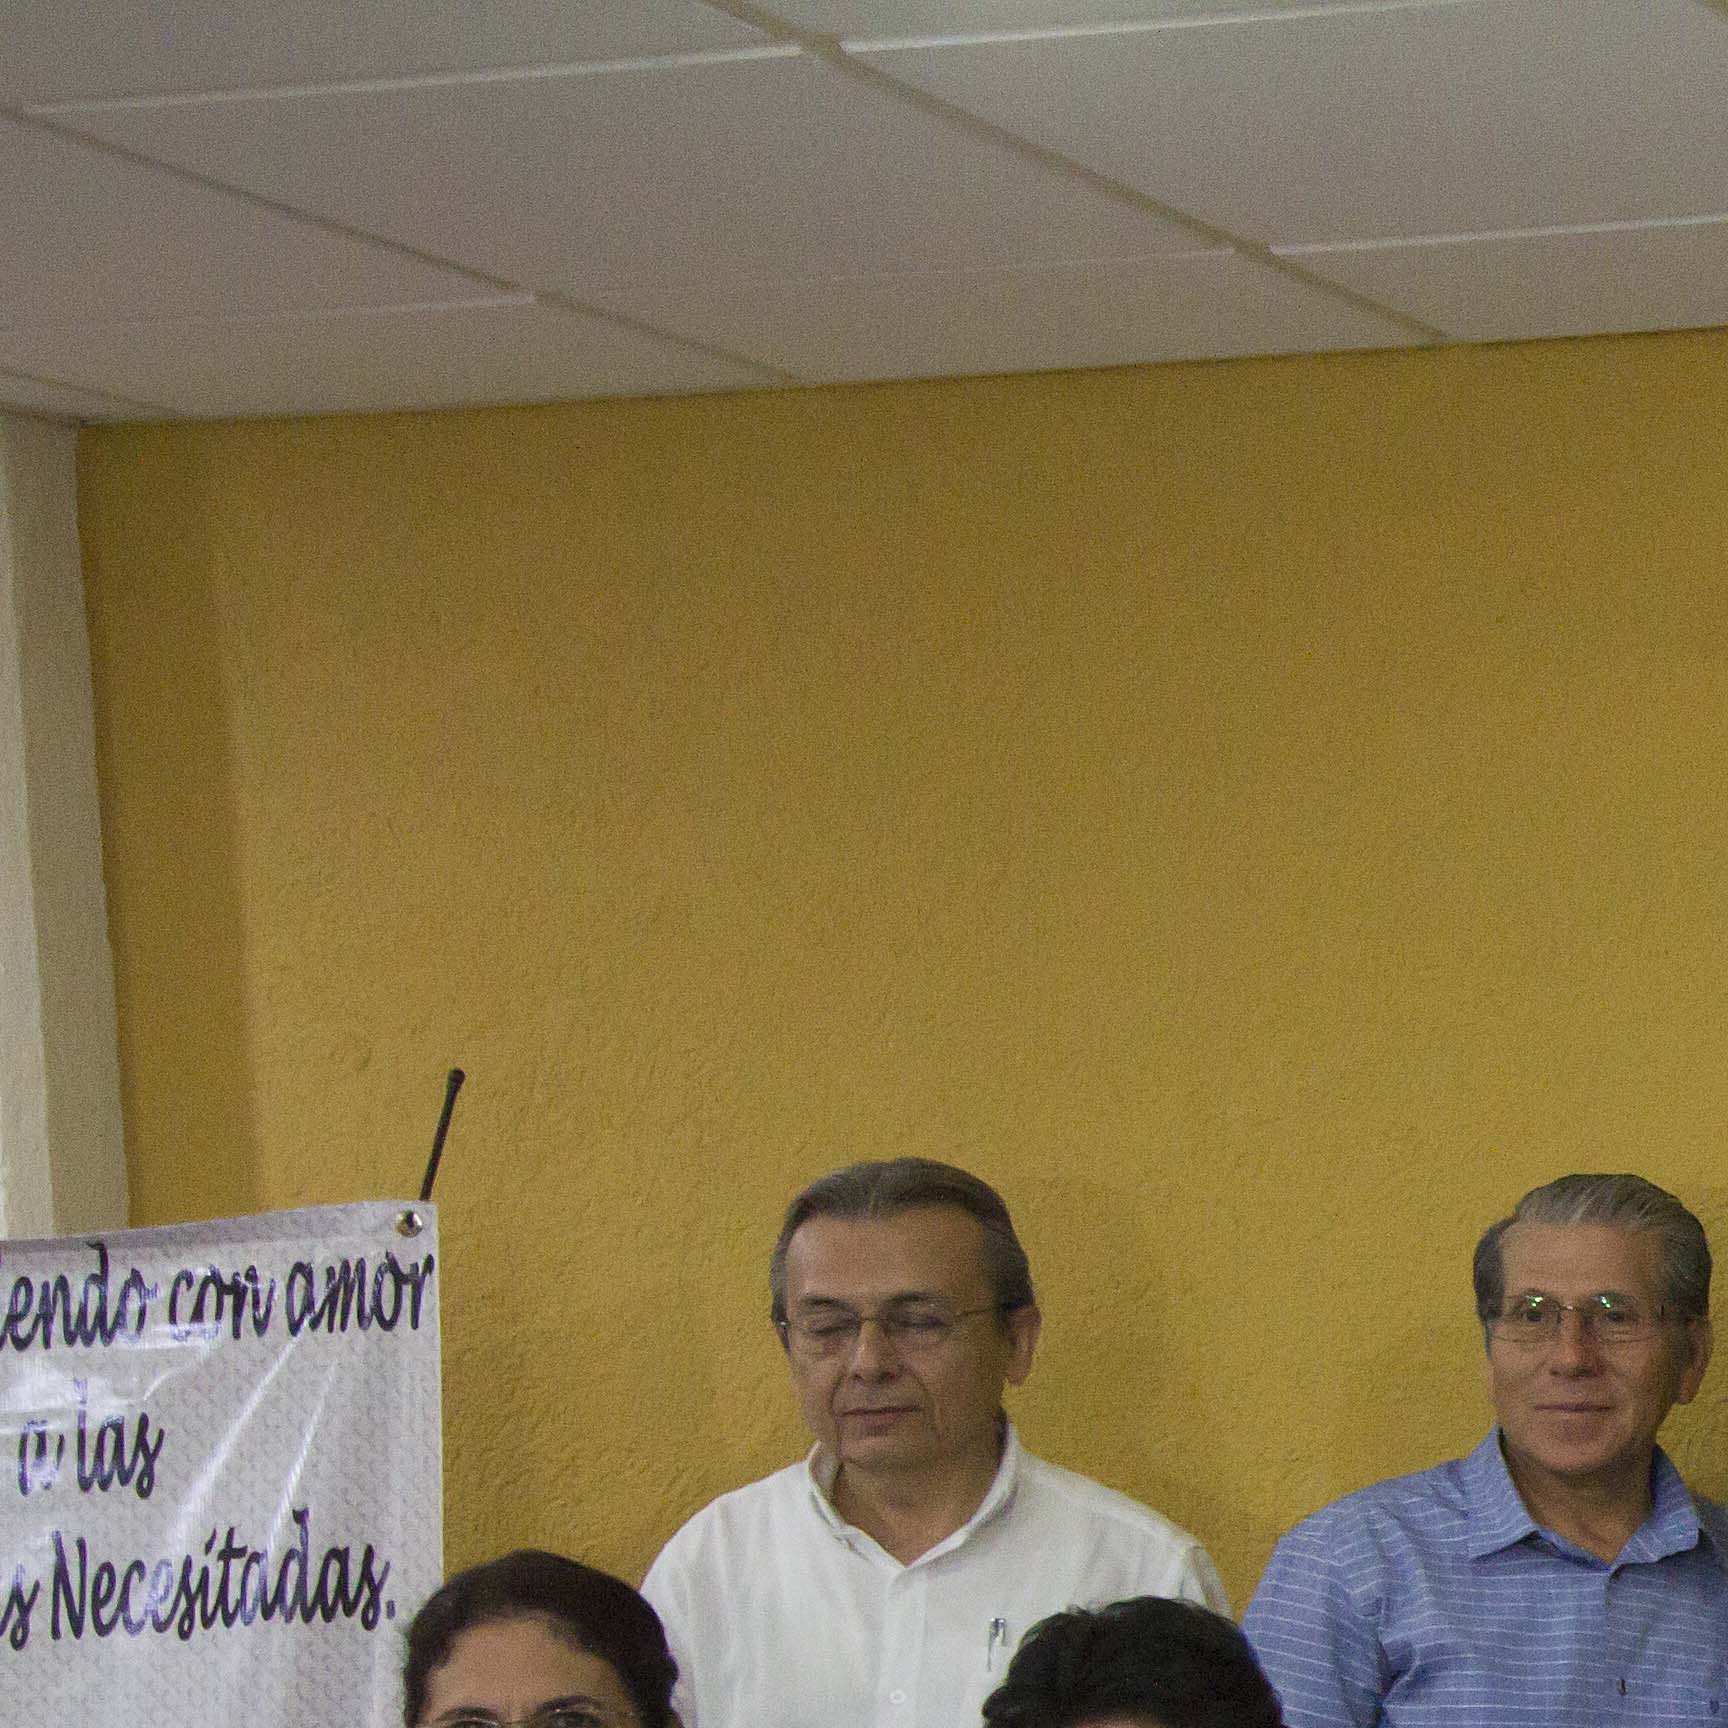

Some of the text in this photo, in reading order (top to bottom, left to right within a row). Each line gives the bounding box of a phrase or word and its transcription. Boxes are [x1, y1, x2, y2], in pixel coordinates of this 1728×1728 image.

[0, 1240, 435, 1352] endo con amor
[74, 1378, 165, 1498] las
